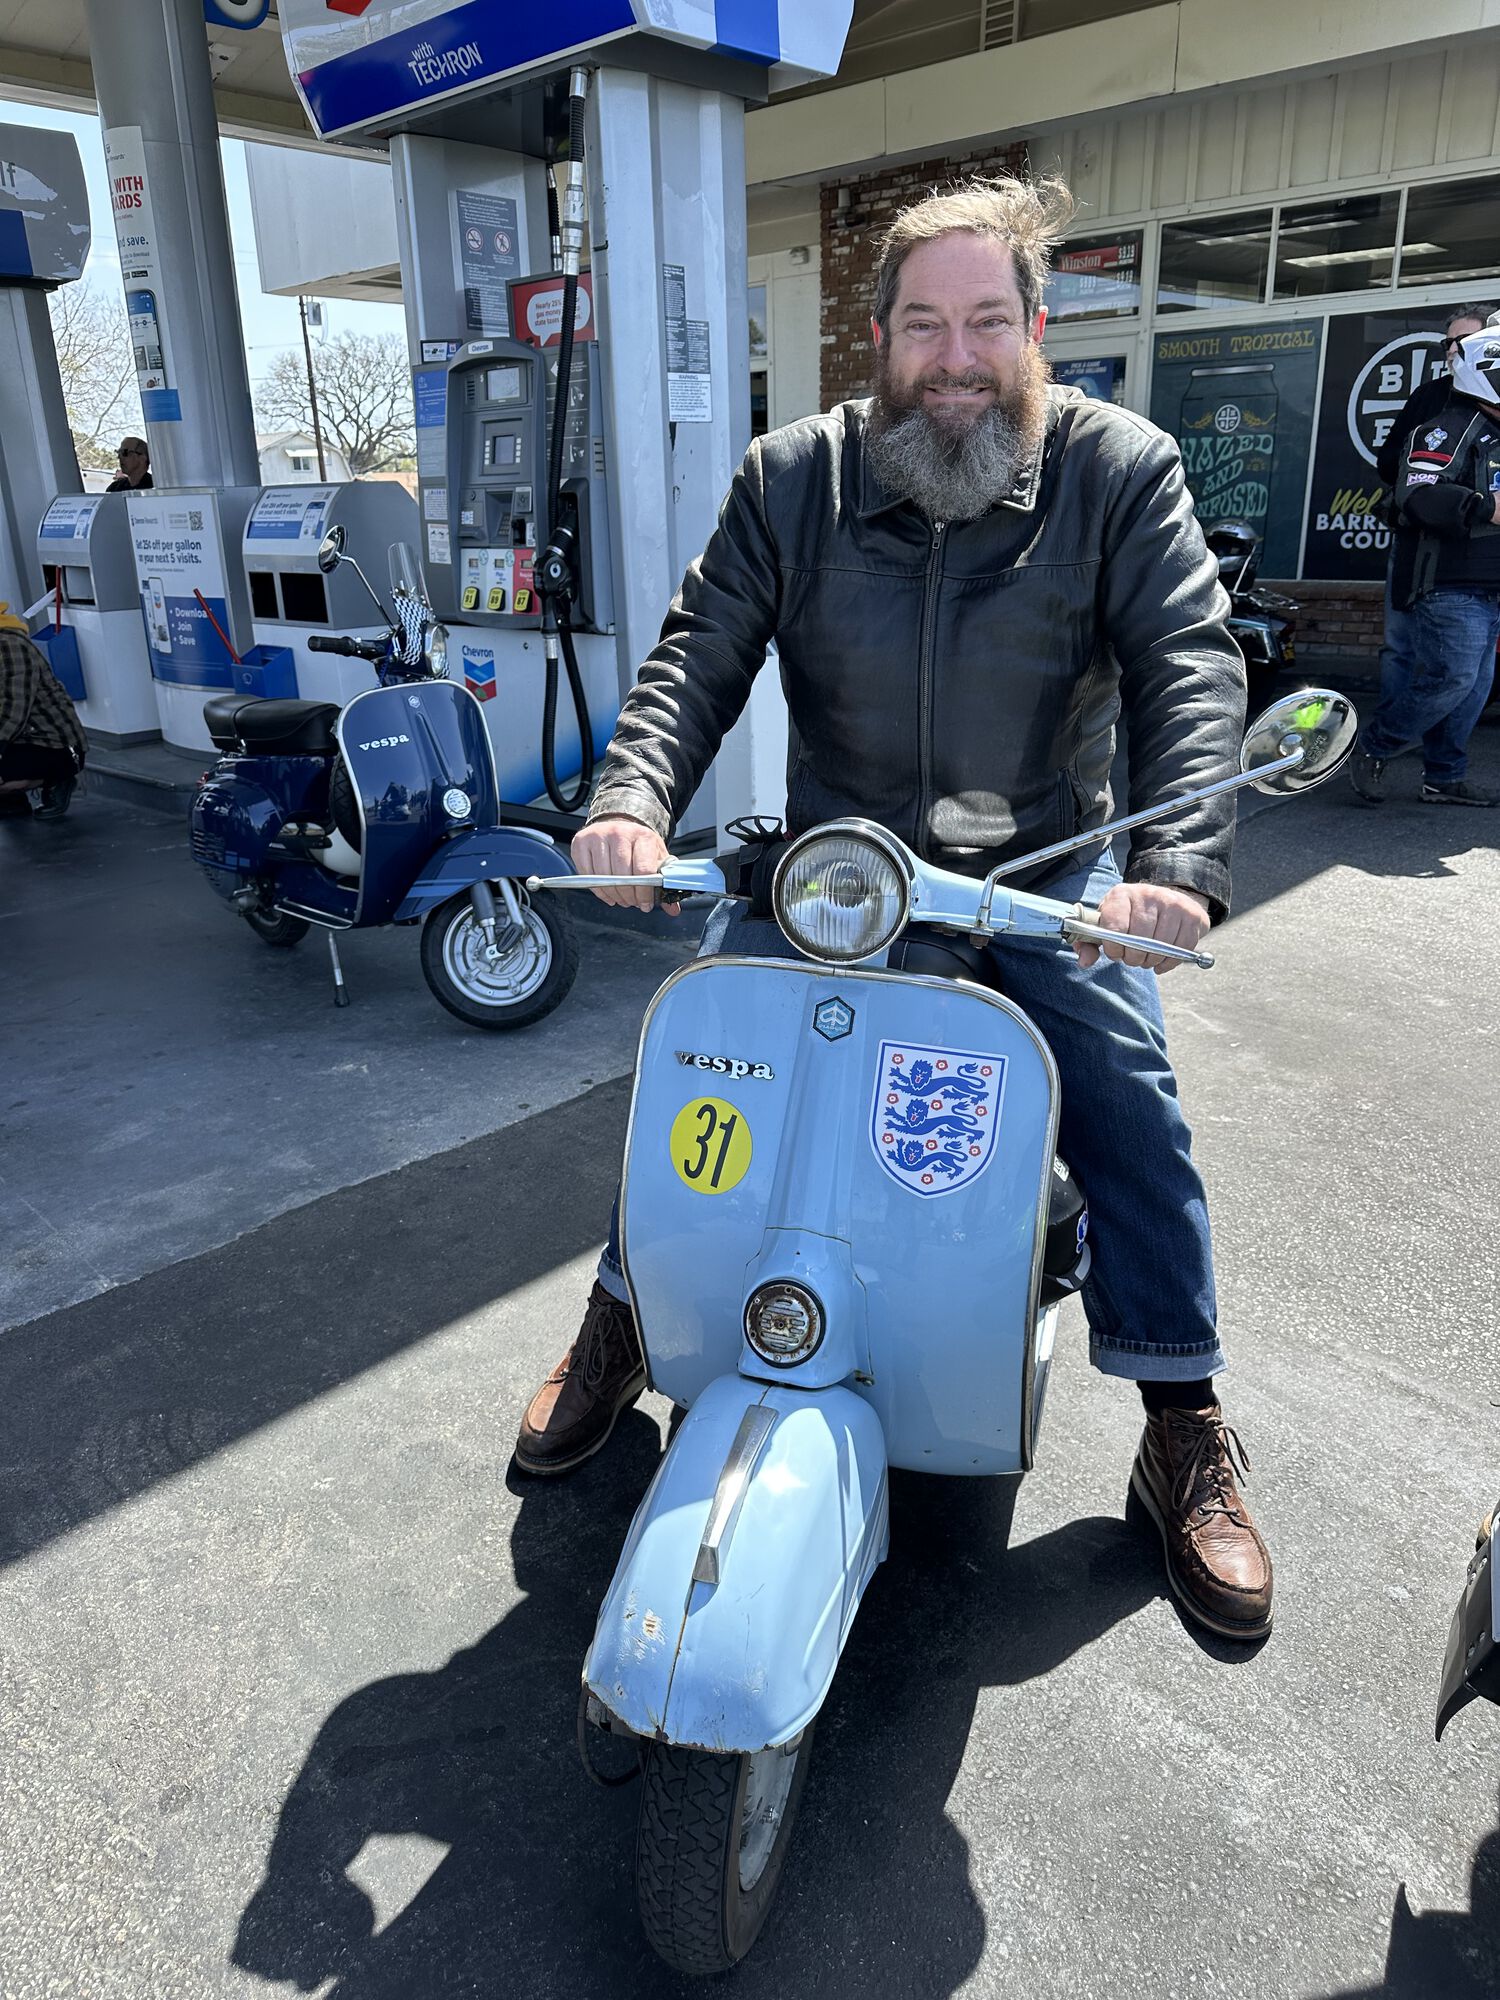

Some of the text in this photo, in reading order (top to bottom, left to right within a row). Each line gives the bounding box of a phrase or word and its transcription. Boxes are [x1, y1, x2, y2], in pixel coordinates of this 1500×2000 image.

[411, 41, 435, 61] with
[407, 42, 483, 86] TECHRON
[114, 175, 144, 193] WITH
[127, 235, 149, 247] save.
[1061, 255, 1102, 270] Winston
[1158, 330, 1315, 359] SMOOTH TROPICAL
[1377, 364, 1404, 393] B
[1180, 434, 1274, 473] HAZED
[1202, 459, 1244, 496] AND
[1194, 481, 1269, 517] NFUSED
[1329, 488, 1383, 516] Wel
[152, 539, 161, 550] off
[162, 541, 173, 552] per
[175, 539, 202, 552] gallon
[1340, 532, 1395, 549] COU
[155, 553, 169, 563] next
[170, 553, 175, 563] 5
[176, 552, 202, 563] visits.
[175, 607, 212, 618] Downloa
[177, 621, 193, 632] Join
[178, 635, 196, 646] Save
[462, 644, 494, 658] Chevron
[359, 734, 409, 751] vespa
[673, 1050, 774, 1080] vespa
[684, 1103, 738, 1188] 31
